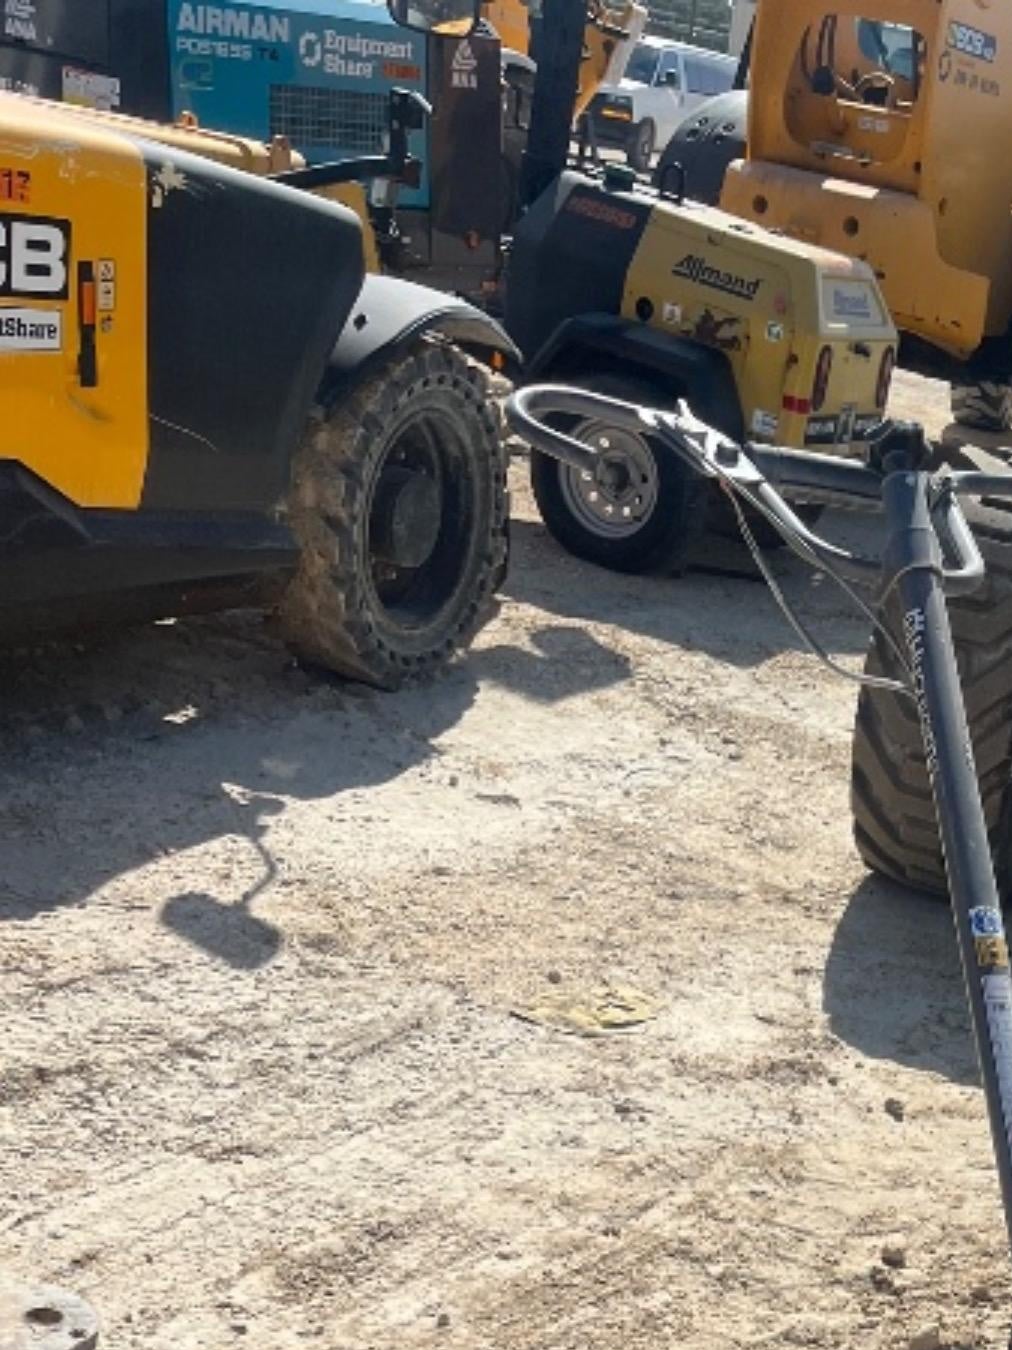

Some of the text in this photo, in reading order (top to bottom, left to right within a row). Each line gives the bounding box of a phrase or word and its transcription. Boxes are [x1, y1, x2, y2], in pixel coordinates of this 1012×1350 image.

[177, 3, 291, 42] AIRMAN
[324, 30, 414, 60] Equipment
[324, 53, 374, 79] Share
